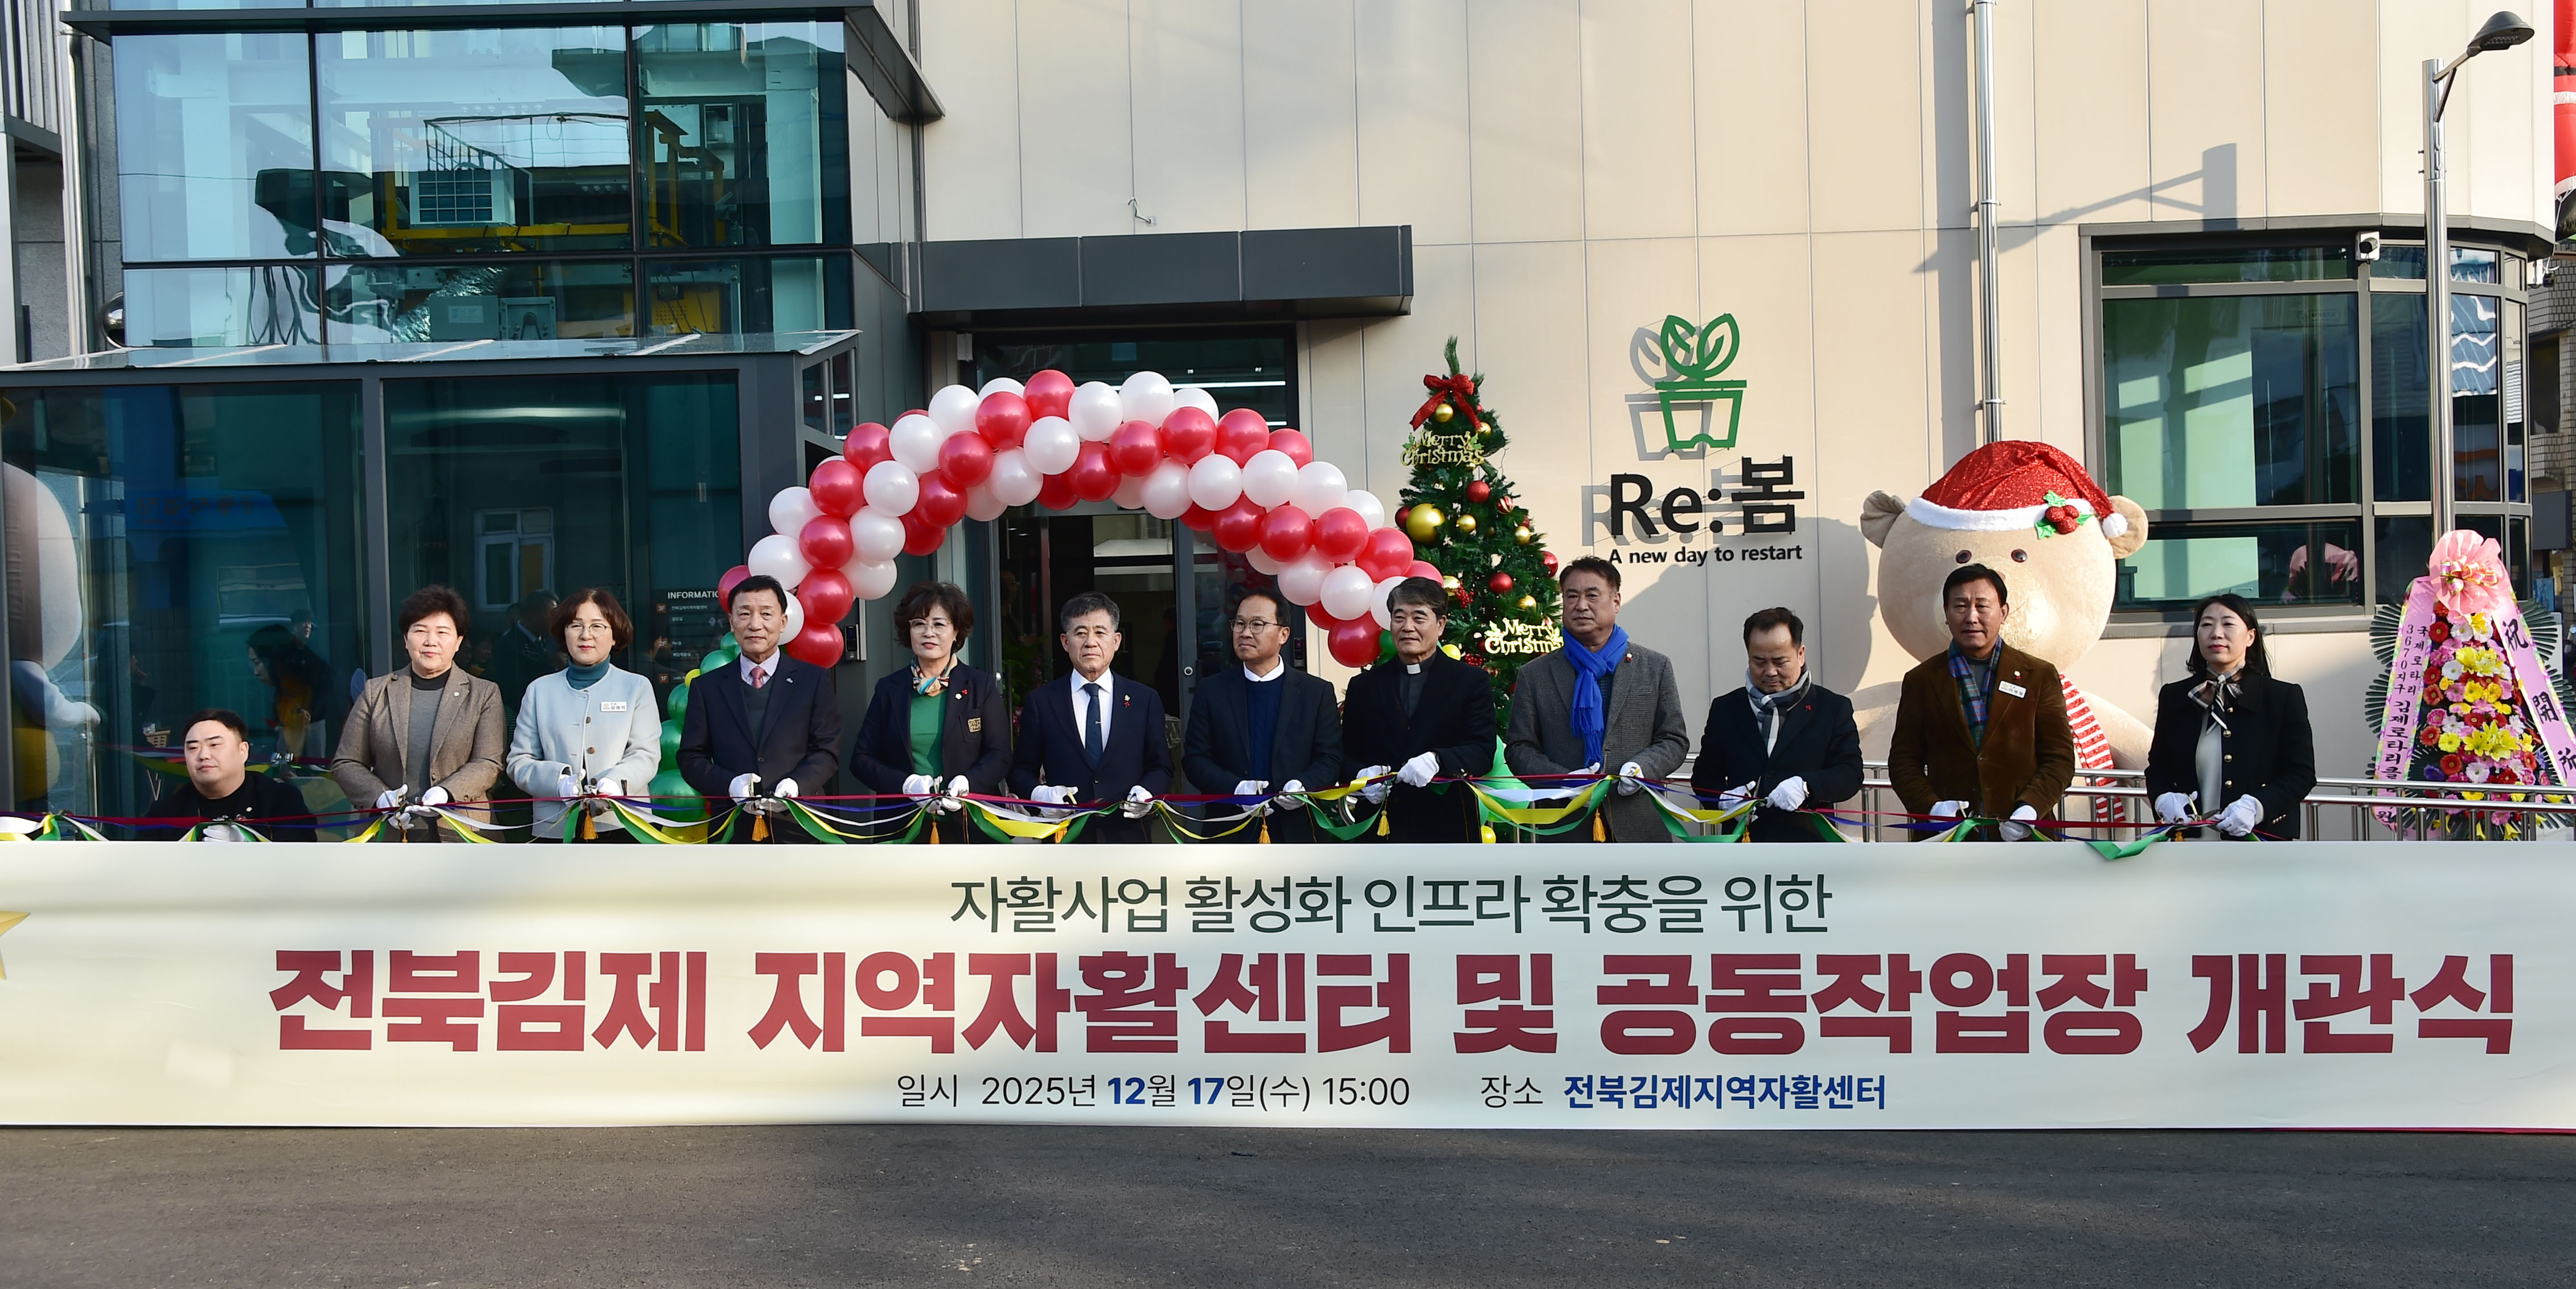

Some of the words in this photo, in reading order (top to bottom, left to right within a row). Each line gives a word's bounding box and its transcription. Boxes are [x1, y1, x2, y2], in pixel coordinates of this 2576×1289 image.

[1400, 445, 1484, 467] Christmas
[1418, 429, 1471, 448] Merry
[1611, 455, 1804, 535] Re:봄
[1609, 549, 1622, 564] A
[1630, 551, 1667, 563] new
[1675, 546, 1708, 567] day
[1714, 547, 1734, 562] to
[1741, 545, 1802, 561] restart
[1502, 617, 1554, 639] Merry
[2394, 624, 2414, 695] 3670지구
[2407, 625, 2429, 696] 국제로타리
[950, 875, 1167, 933] 자활사업
[1184, 875, 1352, 934] 활성화
[1364, 875, 1531, 934] 인프라
[1541, 874, 1708, 934] 확충을
[1721, 874, 1833, 934] 위한
[269, 950, 707, 1052] 전북김제
[747, 951, 1411, 1054] 지역자활센터
[1453, 953, 1558, 1054] 및
[1597, 952, 2148, 1055] 공동작업장
[2186, 954, 2513, 1054] 개관식
[897, 1074, 957, 1107] 일시
[982, 1074, 1096, 1107] 2025년
[1107, 1074, 1176, 1107] 12월
[1188, 1074, 1310, 1112] 17일(수)
[1322, 1077, 1409, 1106] 15:00
[1480, 1075, 1543, 1108] 장소
[1564, 1074, 1885, 1110] 전북김제지역자활센터
